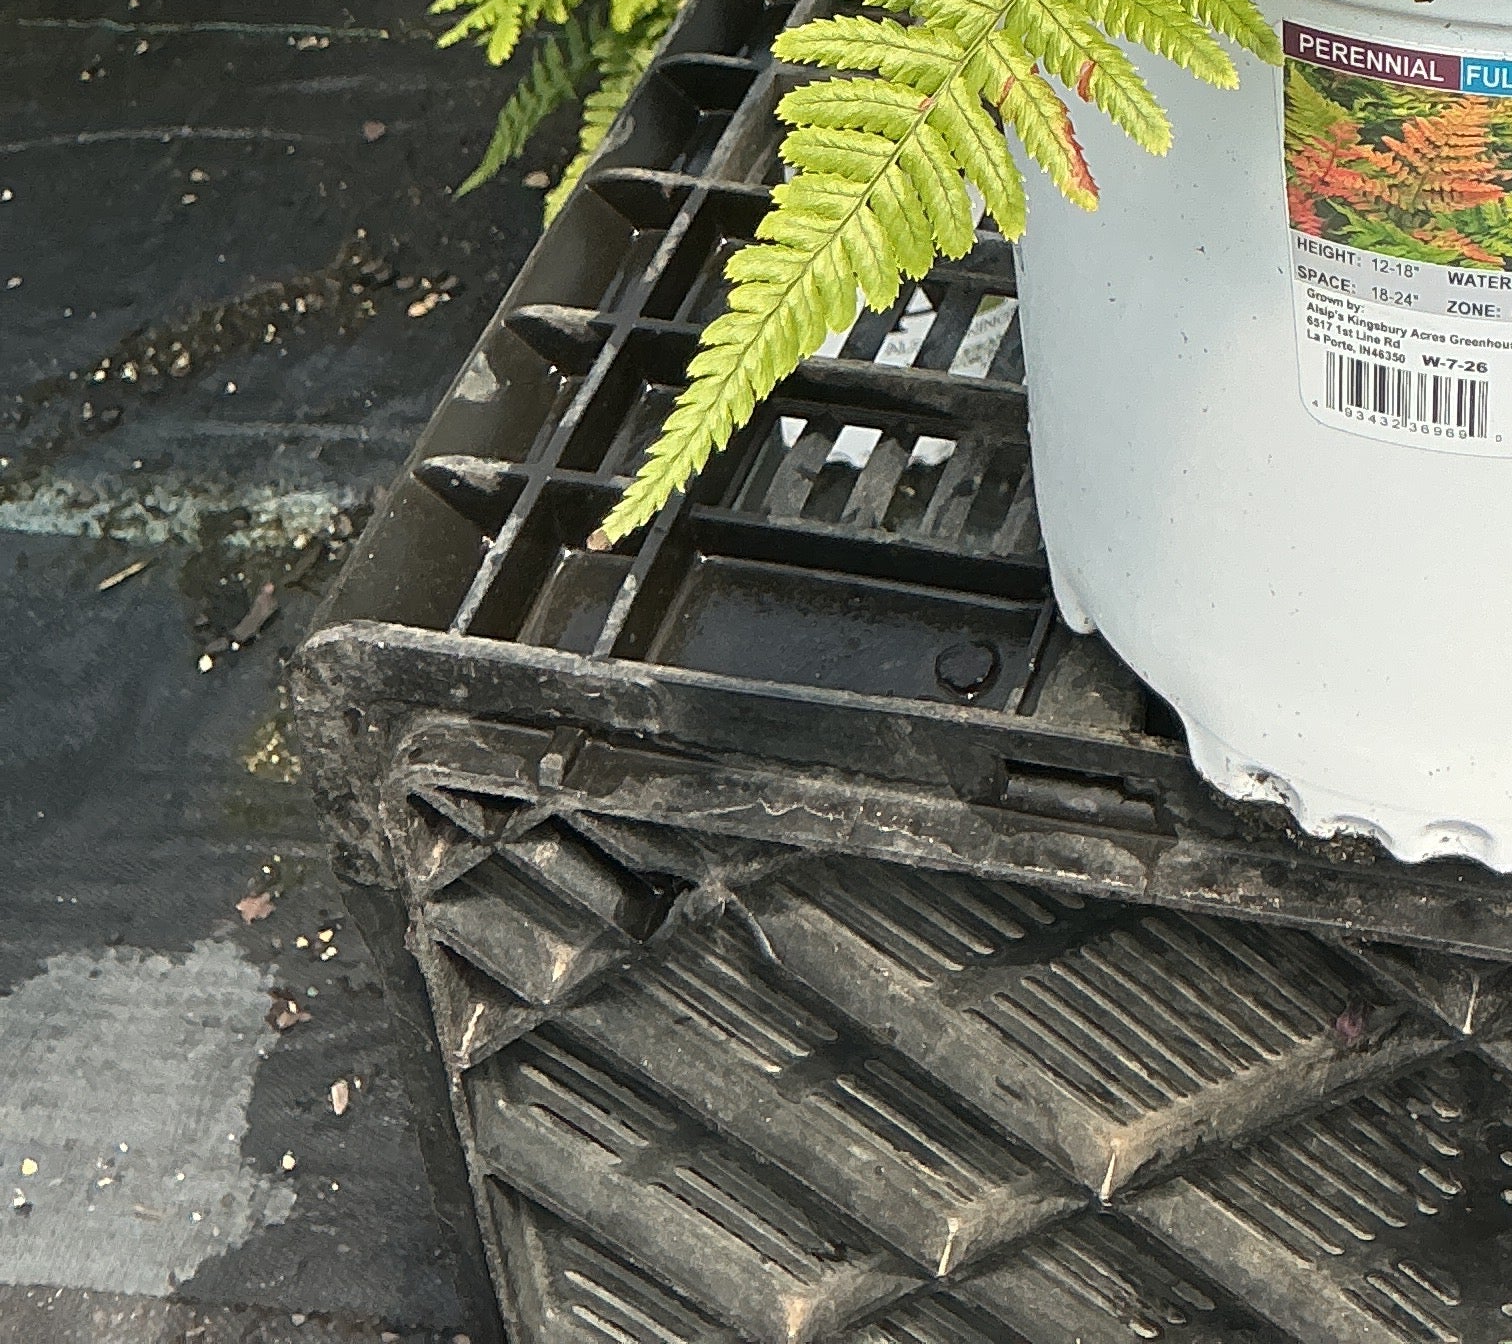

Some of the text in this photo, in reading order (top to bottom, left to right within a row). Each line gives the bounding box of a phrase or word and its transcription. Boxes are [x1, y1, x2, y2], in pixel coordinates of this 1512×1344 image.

[1298, 32, 1445, 83] PERENNIAL
[1297, 235, 1420, 278] HEIGHT: 12-18"
[1297, 265, 1420, 307] SPACE: 18-24"
[1306, 287, 1344, 308] Grown
[1306, 301, 1345, 322] Alsip's
[1347, 312, 1408, 339] Kingsbury
[1410, 328, 1446, 344] Acres
[1447, 300, 1502, 319] ZONE:
[1306, 328, 1321, 341] La
[1336, 323, 1354, 337] 1st
[1356, 328, 1382, 346] Line
[1384, 335, 1401, 350] Rd
[1422, 354, 1488, 373] W-7-26
